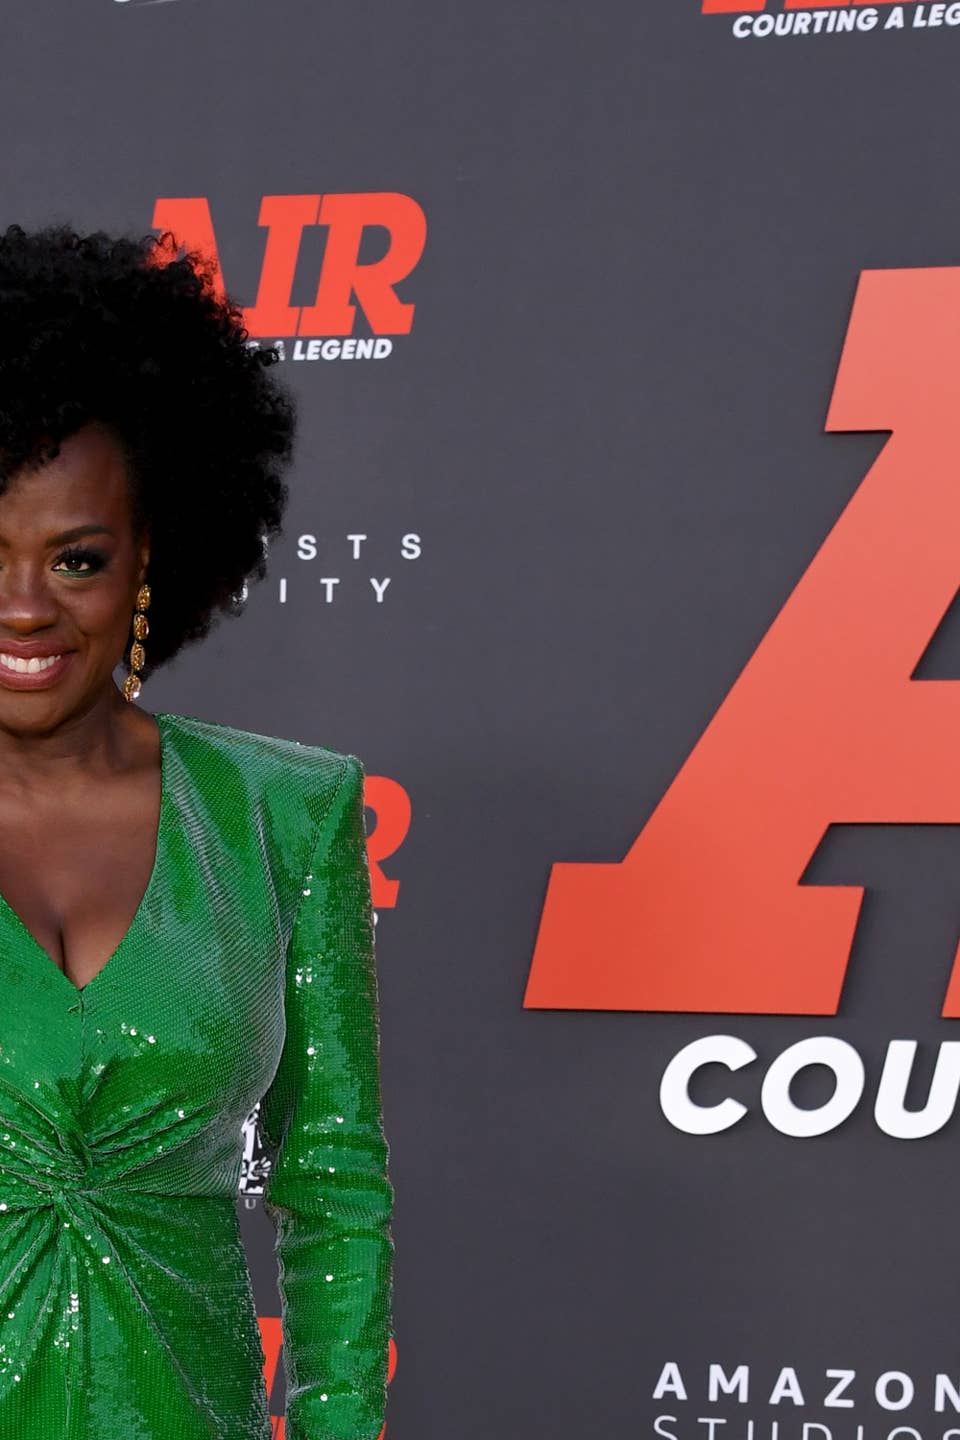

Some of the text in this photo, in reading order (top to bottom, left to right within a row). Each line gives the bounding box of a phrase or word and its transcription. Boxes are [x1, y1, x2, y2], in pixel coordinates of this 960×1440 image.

[732, 7, 879, 39] COURTING
[883, 6, 905, 30] A
[292, 338, 393, 361] LEGEND
